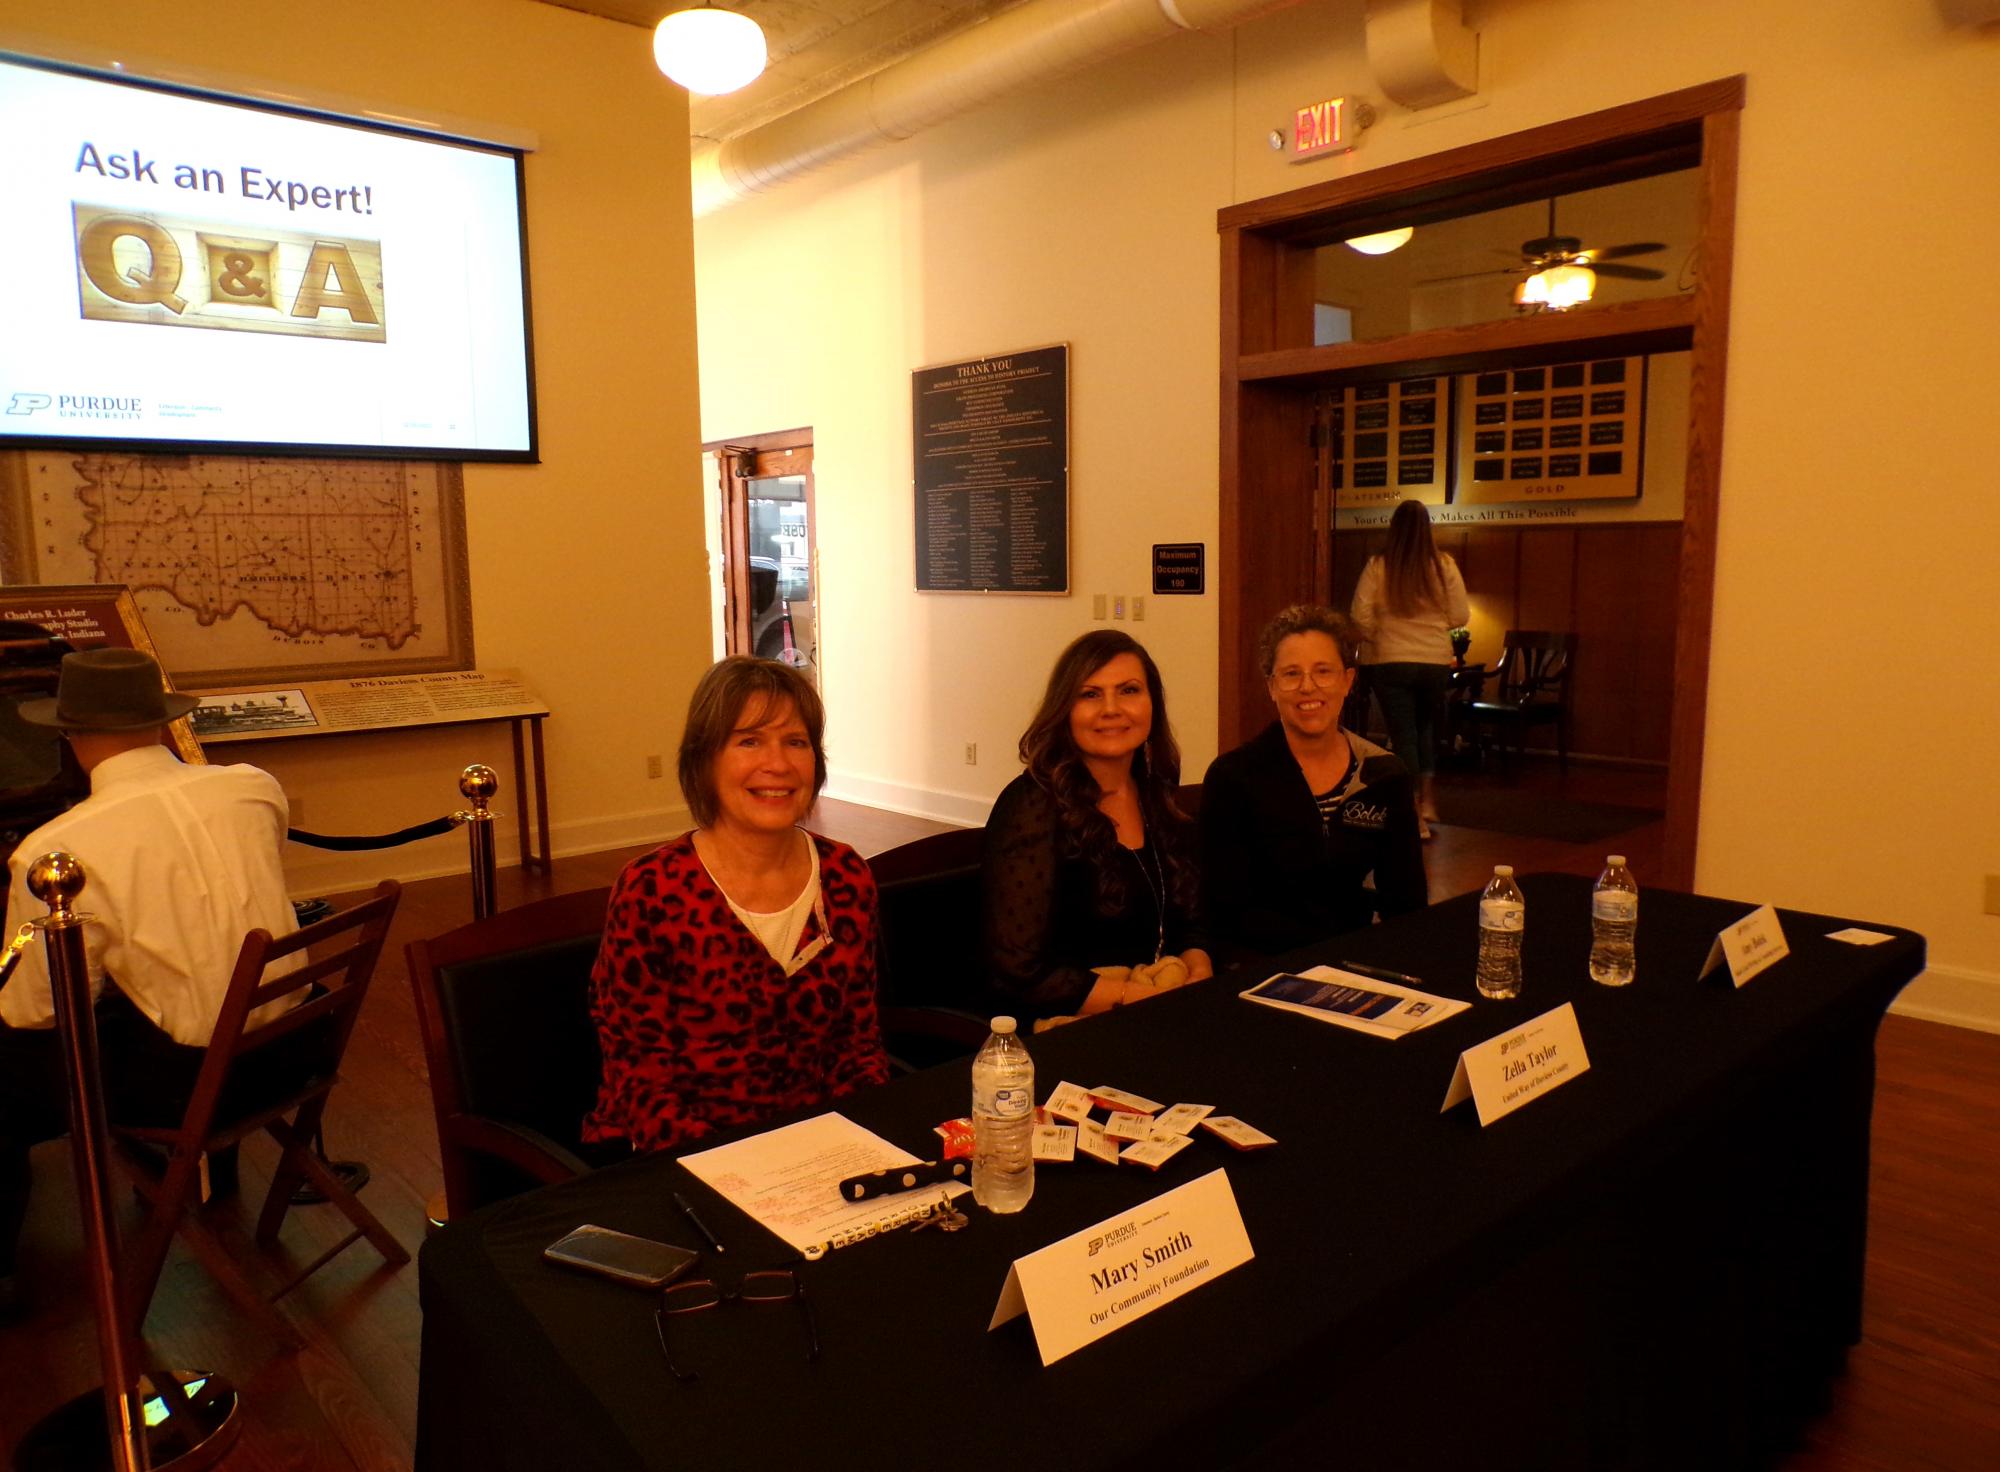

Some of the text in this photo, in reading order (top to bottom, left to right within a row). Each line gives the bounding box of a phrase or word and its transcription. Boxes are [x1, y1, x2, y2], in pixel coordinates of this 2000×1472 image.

[1296, 97, 1344, 151] EXIT
[75, 141, 373, 215] Ask an Expert!
[78, 213, 379, 325] Q & A
[956, 359, 1012, 378] THANK YOU
[59, 394, 142, 412] PURDUE
[59, 410, 142, 420] UNIVERSITY
[1525, 484, 1565, 494] GOLD
[1354, 515, 1377, 525] Your
[1440, 512, 1475, 521] Makes
[1478, 511, 1494, 520] All
[1499, 509, 1524, 519] This
[1528, 507, 1577, 518] Possible
[1159, 551, 1197, 559] Maximum
[1157, 565, 1200, 575] Occupancy
[4, 609, 44, 620] Charles
[66, 618, 99, 628] Studio
[68, 629, 106, 639] Indiana
[350, 681, 375, 689] 1876
[420, 675, 458, 684] County
[460, 672, 485, 681] Map
[1502, 1045, 1558, 1082] Zella Taylor
[1104, 1222, 1137, 1243] PURDUE
[1107, 1231, 1138, 1249] UNIVERSITY
[1090, 1231, 1193, 1295] Mary Smith
[1090, 1257, 1210, 1325] Our Community Foundation
